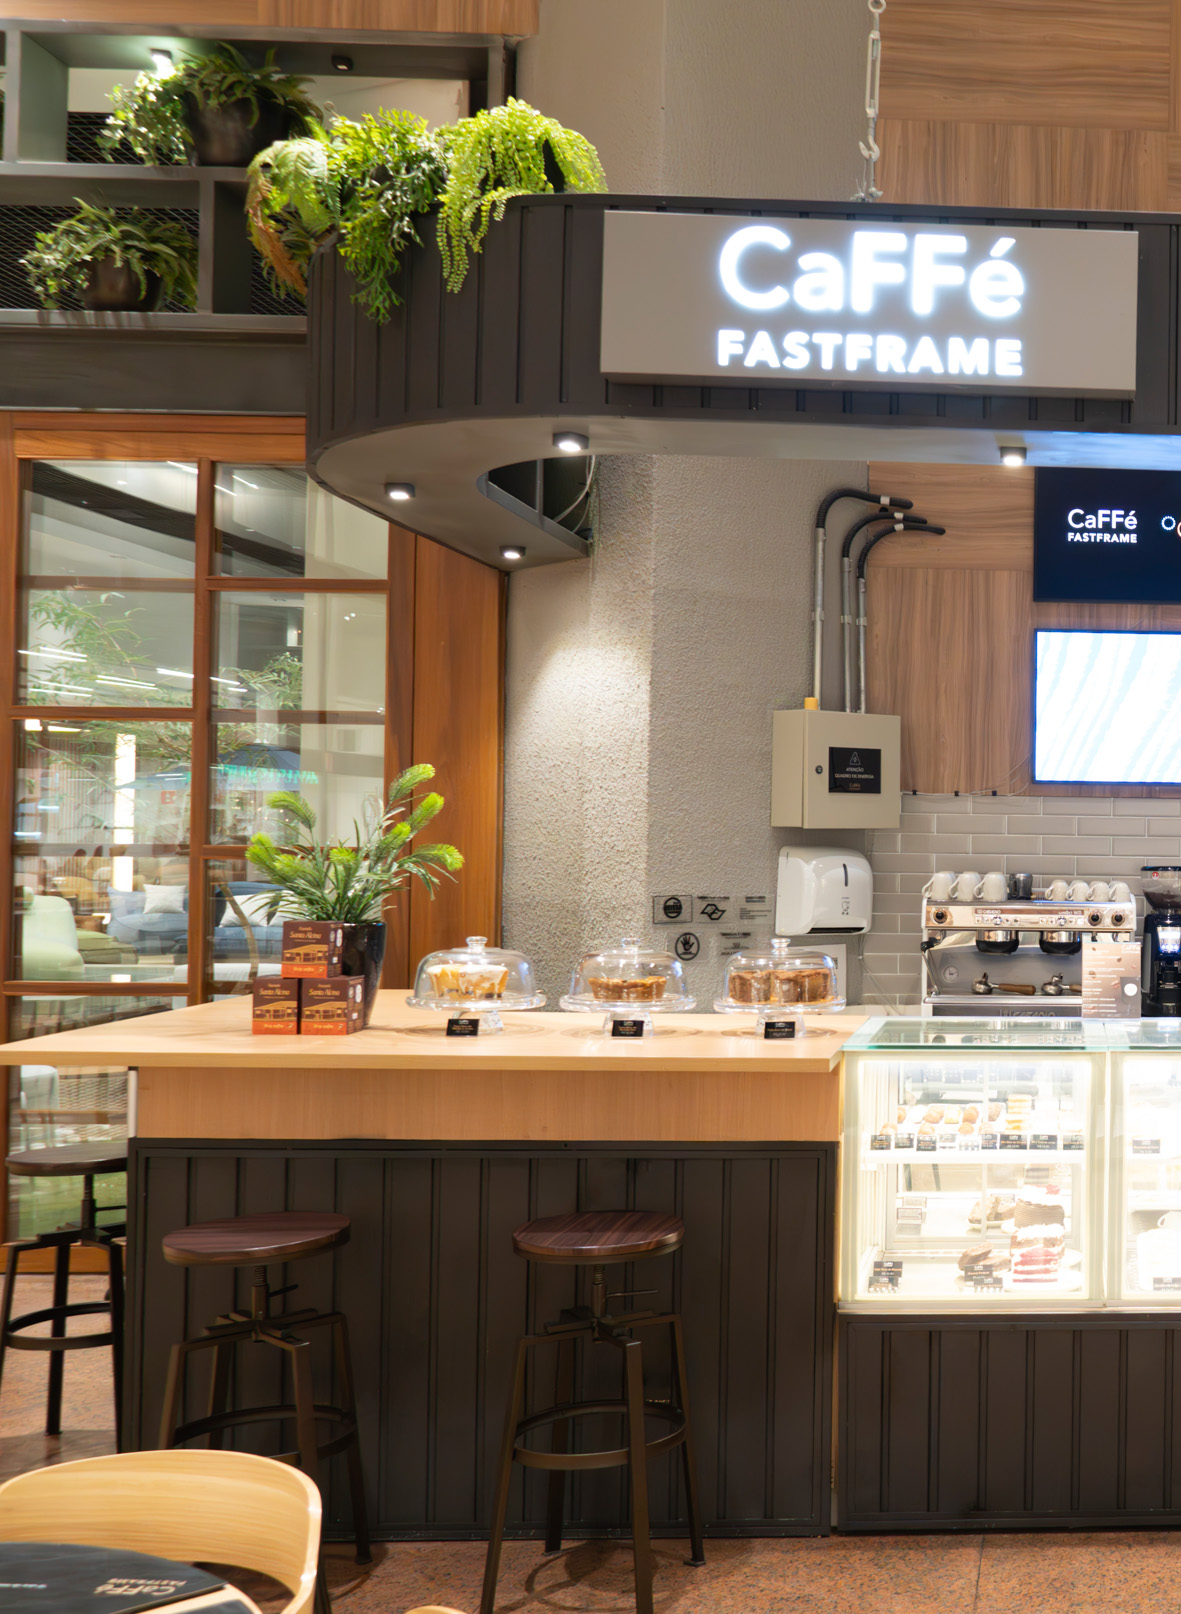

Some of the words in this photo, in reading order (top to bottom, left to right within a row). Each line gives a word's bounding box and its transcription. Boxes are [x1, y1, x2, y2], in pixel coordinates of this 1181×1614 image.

[719, 225, 1026, 318] CaFFé
[717, 329, 1023, 376] FASTFRAME
[1067, 508, 1138, 530] CaFFé
[1067, 532, 1138, 543] FASTFRAME
[308, 988, 324, 996] Santa
[94, 1584, 176, 1595] CaFFé
